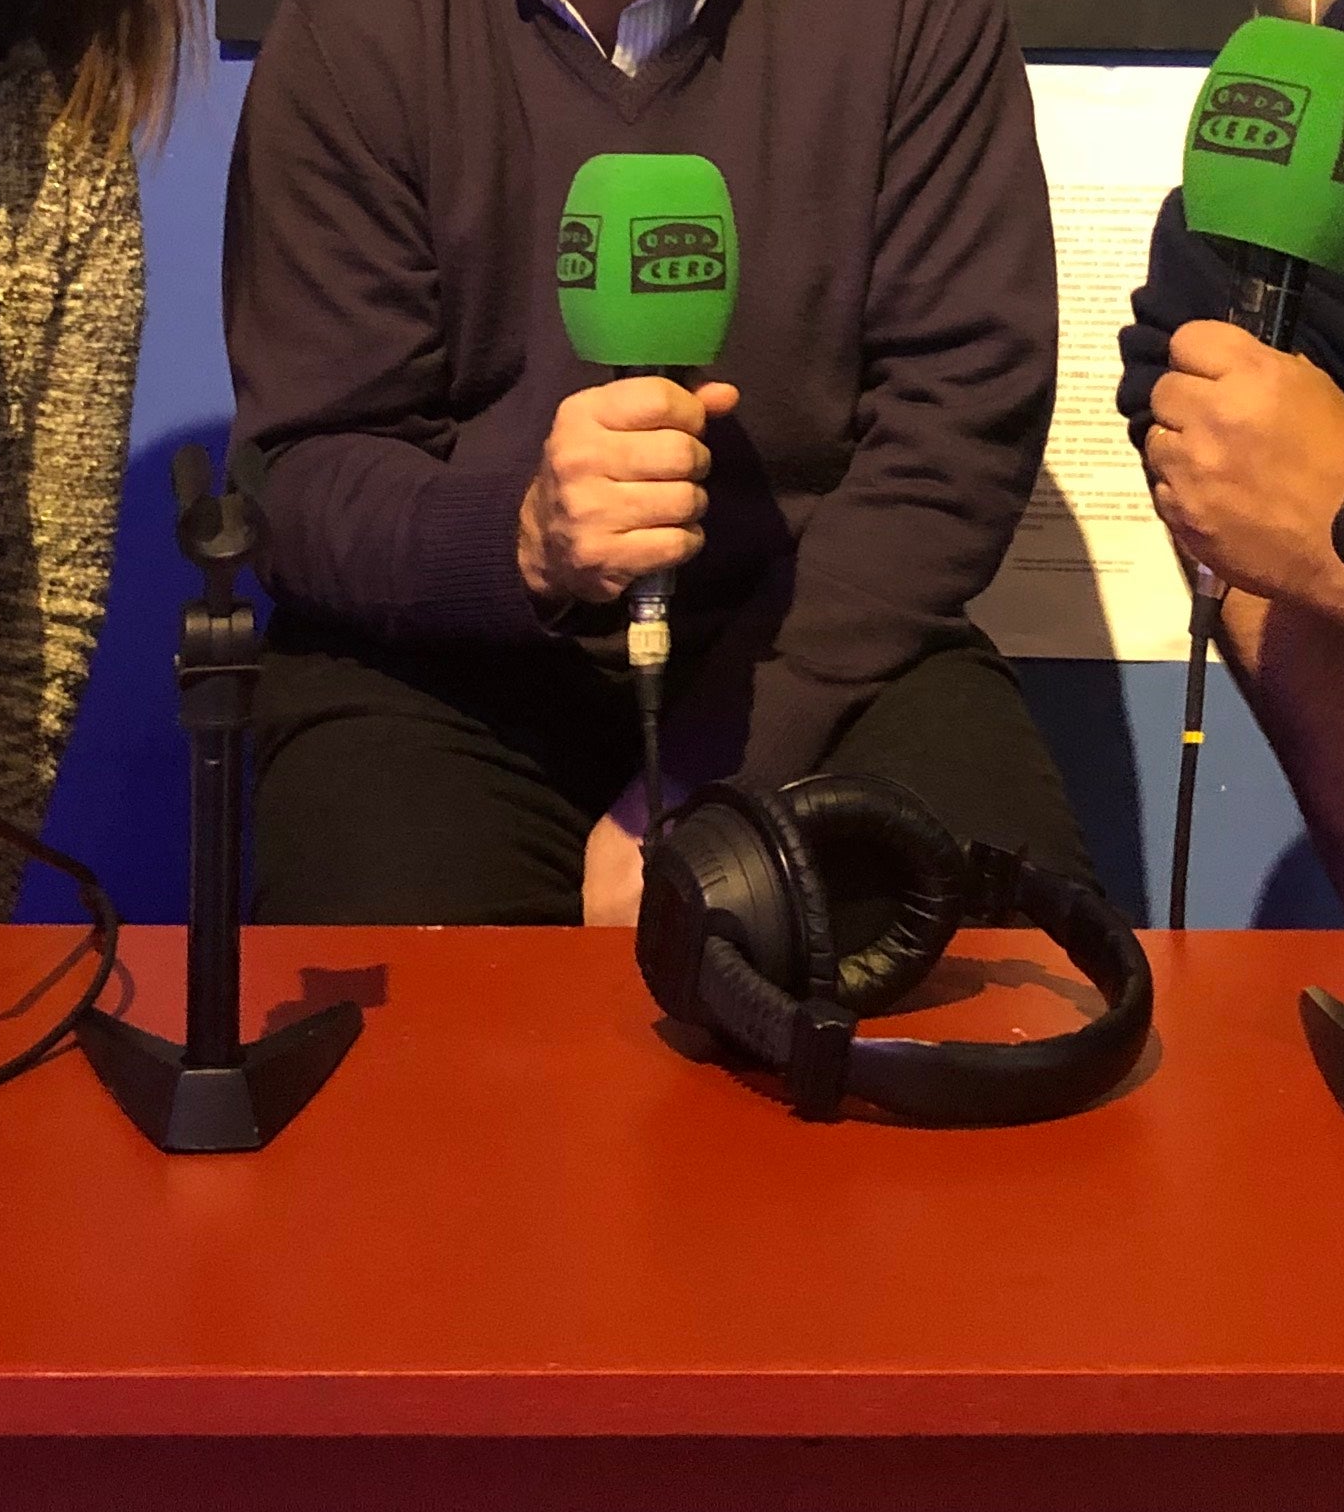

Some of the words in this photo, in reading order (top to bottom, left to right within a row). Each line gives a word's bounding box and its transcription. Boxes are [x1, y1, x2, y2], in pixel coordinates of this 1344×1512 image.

[1218, 89, 1286, 112] ONDA
[1209, 120, 1278, 145] CERO
[646, 234, 712, 248] ONDA
[651, 260, 714, 279] CERO
